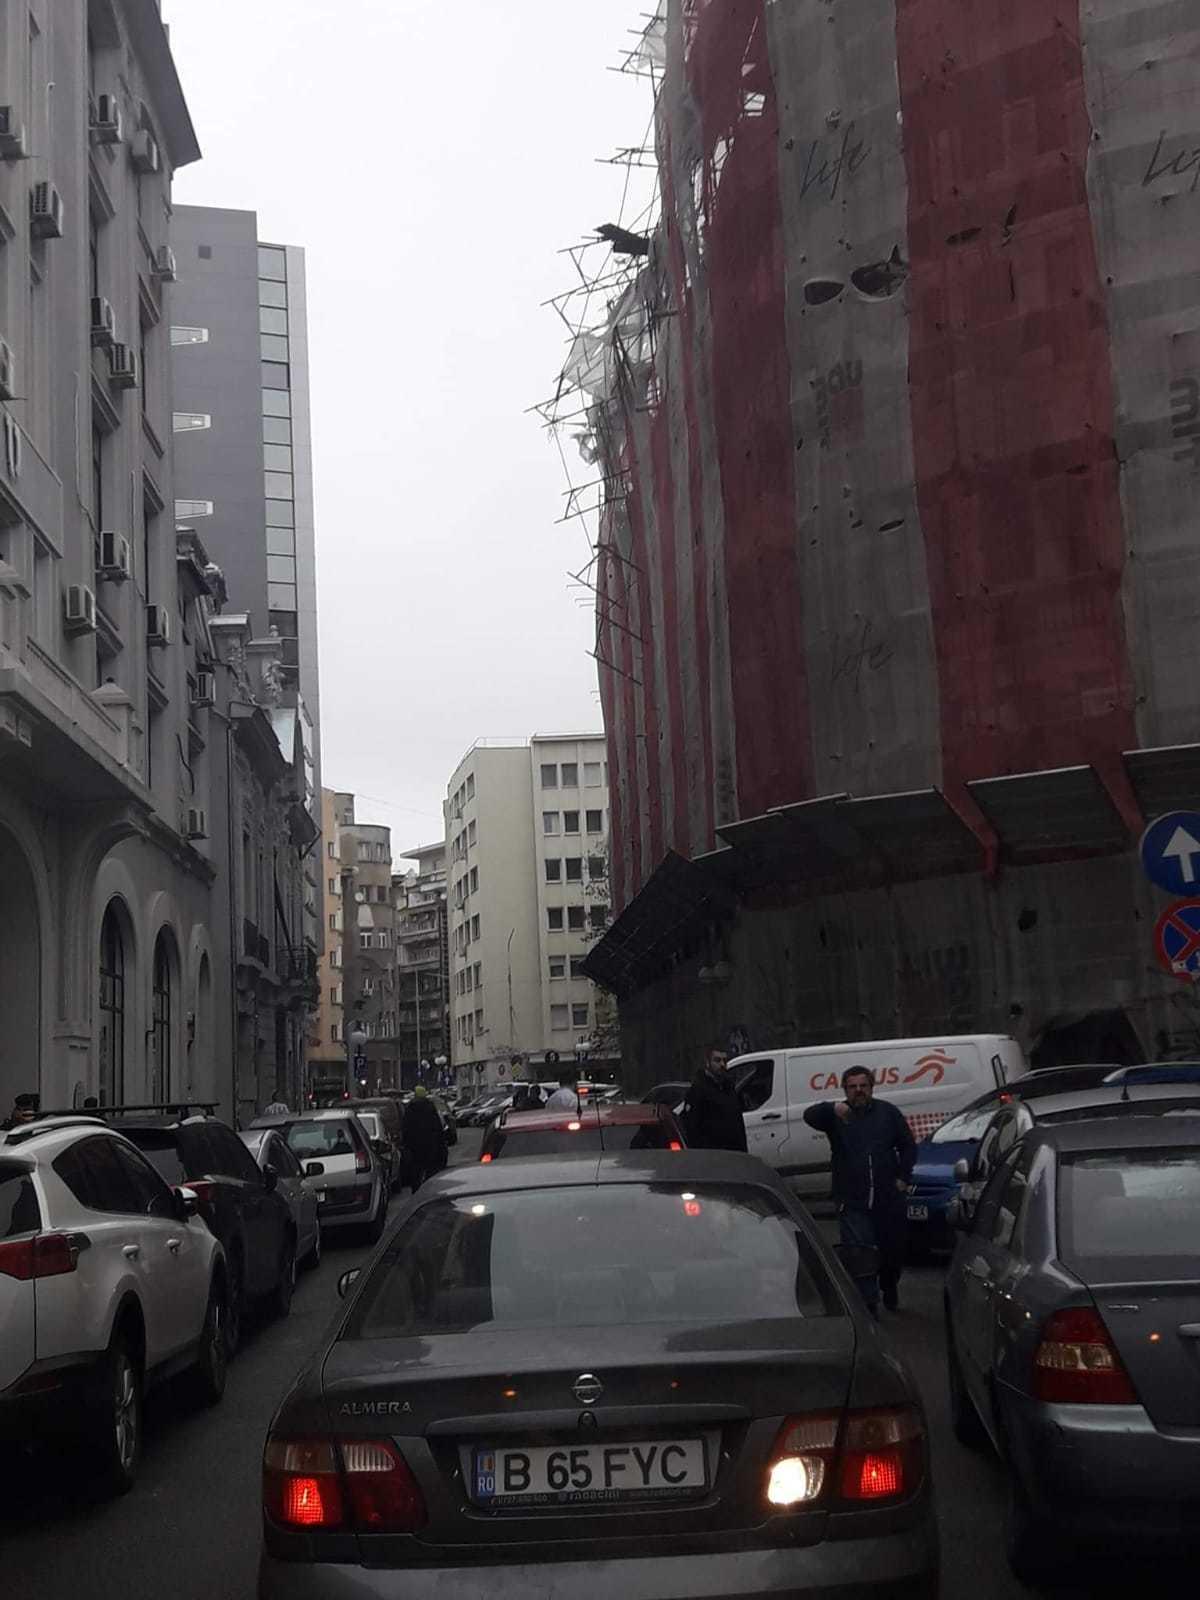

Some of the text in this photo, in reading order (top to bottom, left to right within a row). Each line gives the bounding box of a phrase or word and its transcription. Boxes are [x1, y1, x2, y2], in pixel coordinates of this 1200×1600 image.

[810, 1066, 899, 1090] CAUS
[340, 1401, 413, 1415] ALMERA
[504, 1445, 687, 1492] B 65 FYC
[478, 1477, 494, 1492] RO
